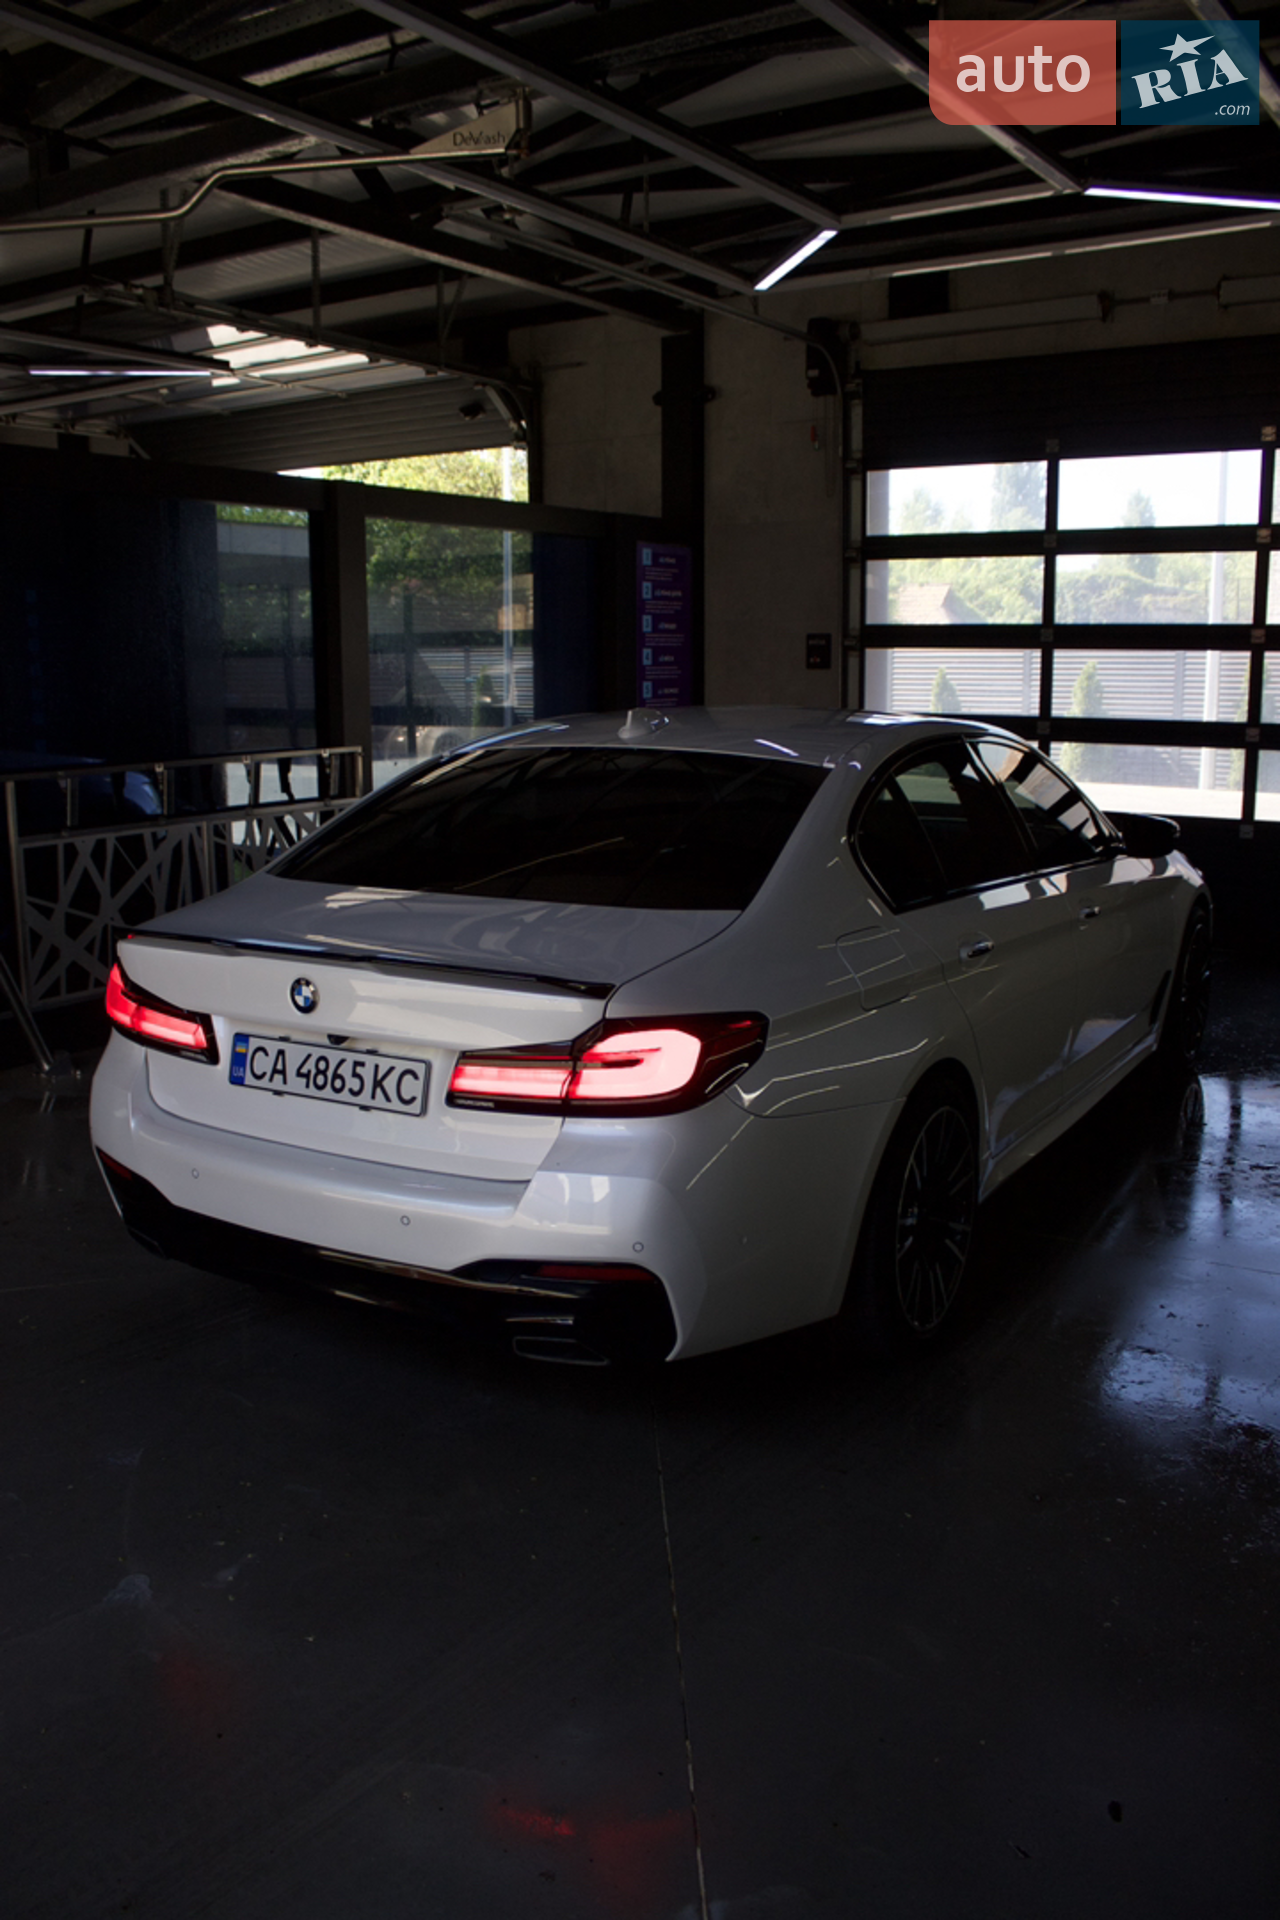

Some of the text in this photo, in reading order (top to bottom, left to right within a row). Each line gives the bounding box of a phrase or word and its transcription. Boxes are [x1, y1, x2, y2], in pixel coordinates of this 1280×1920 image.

[233, 1066, 245, 1078] UA
[249, 1046, 420, 1106] CA 4865 KC
